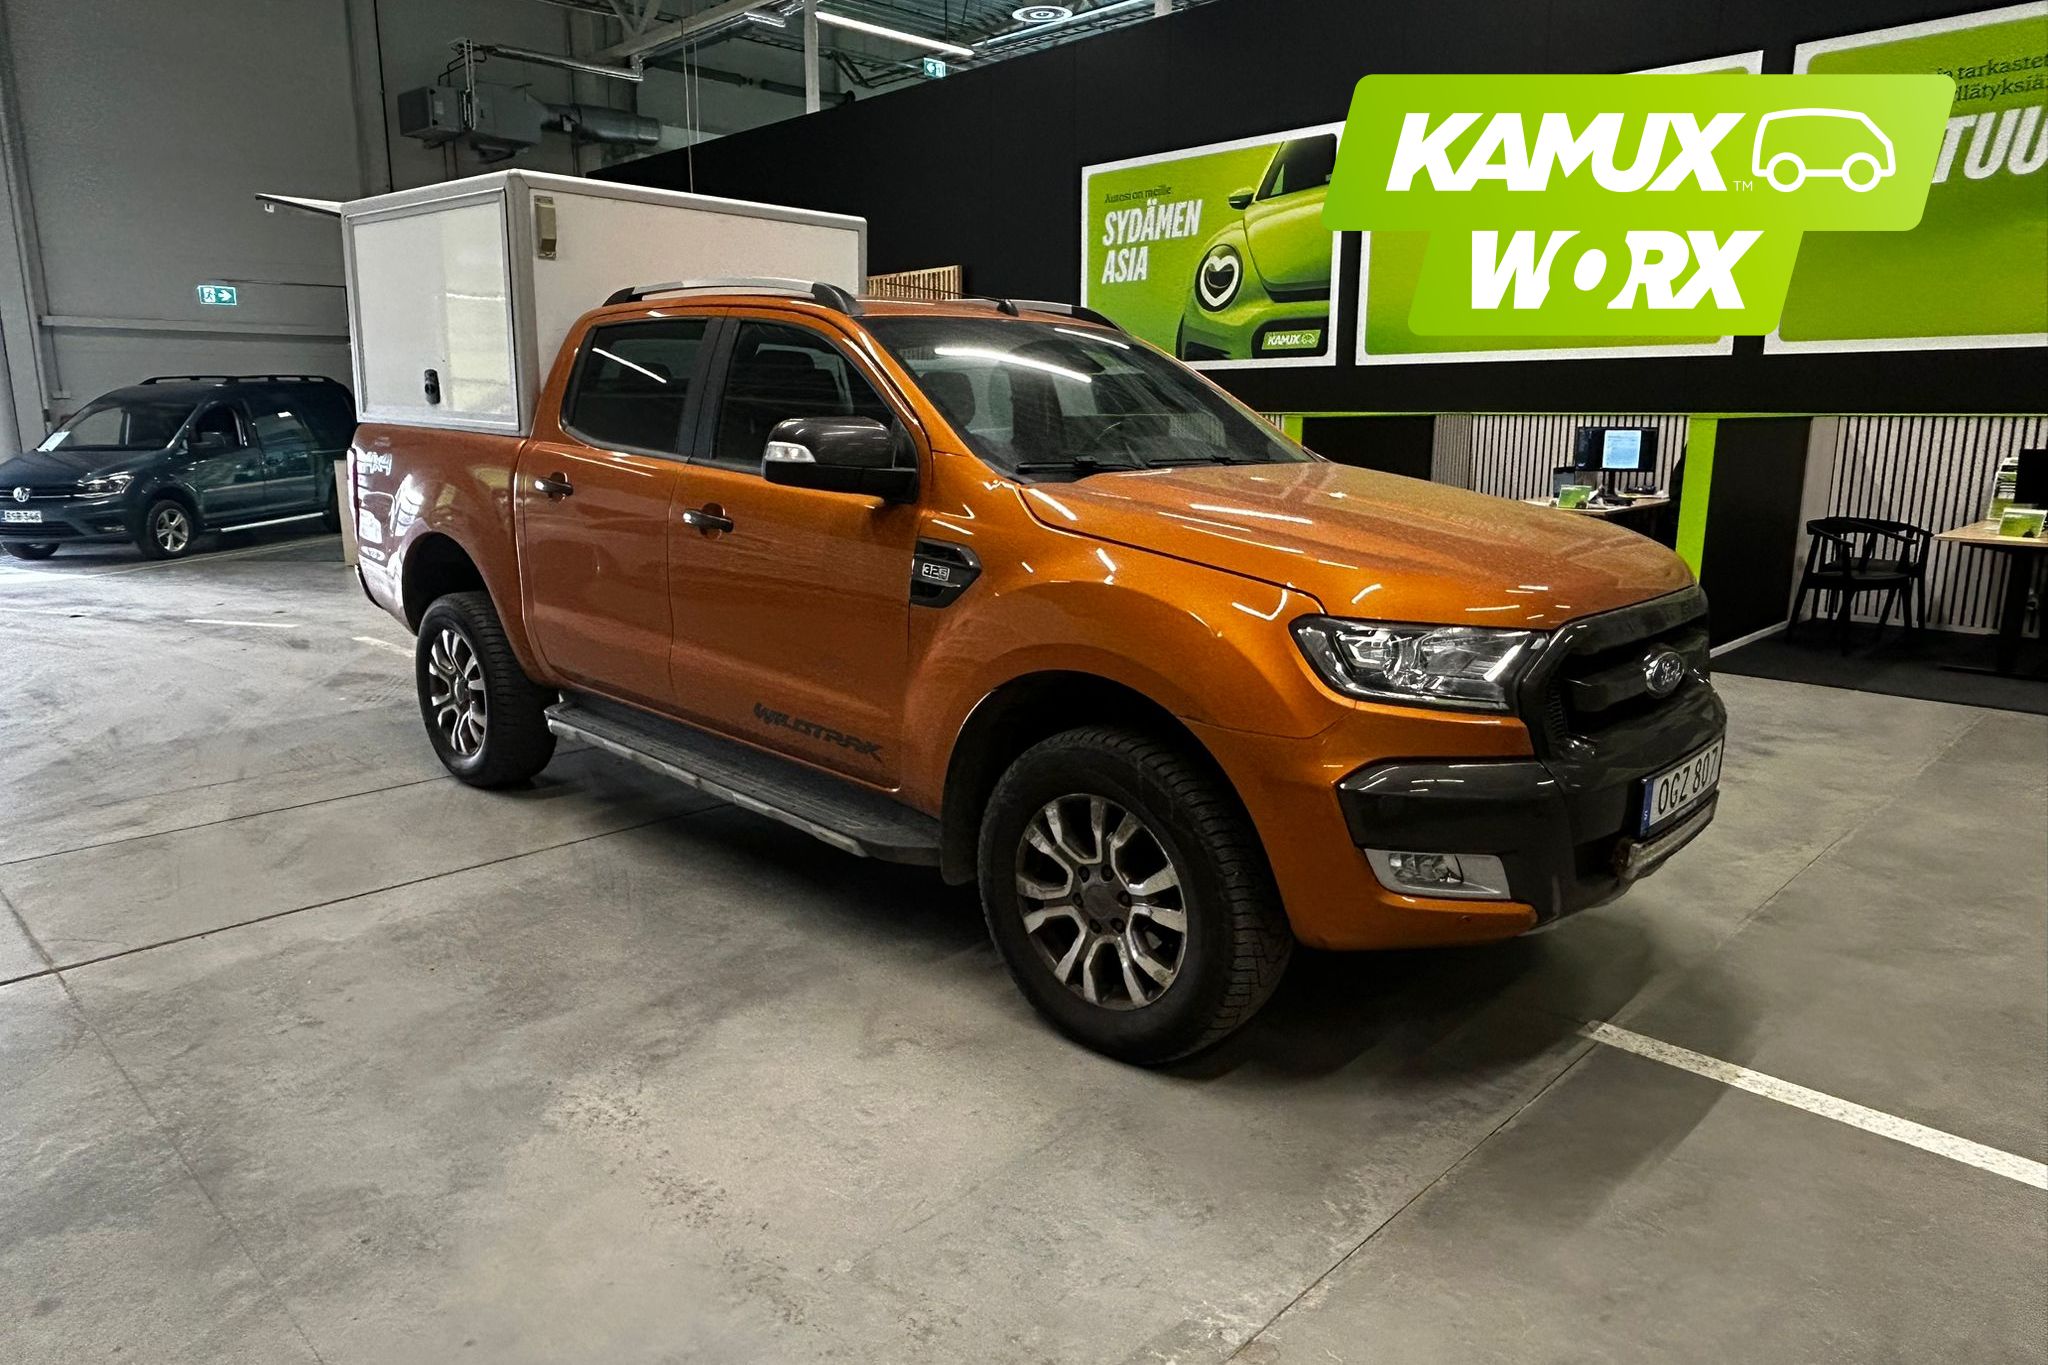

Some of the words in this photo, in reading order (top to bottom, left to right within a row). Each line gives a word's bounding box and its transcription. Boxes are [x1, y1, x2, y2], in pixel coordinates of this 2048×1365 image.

[1102, 198, 1203, 247] SYDÄMEN
[1101, 245, 1148, 285] ASIA
[1267, 334, 1301, 346] KAMUX
[753, 702, 883, 763] WILDTRAK
[1658, 765, 1691, 815] OGZ
[1692, 745, 1719, 793] 807
